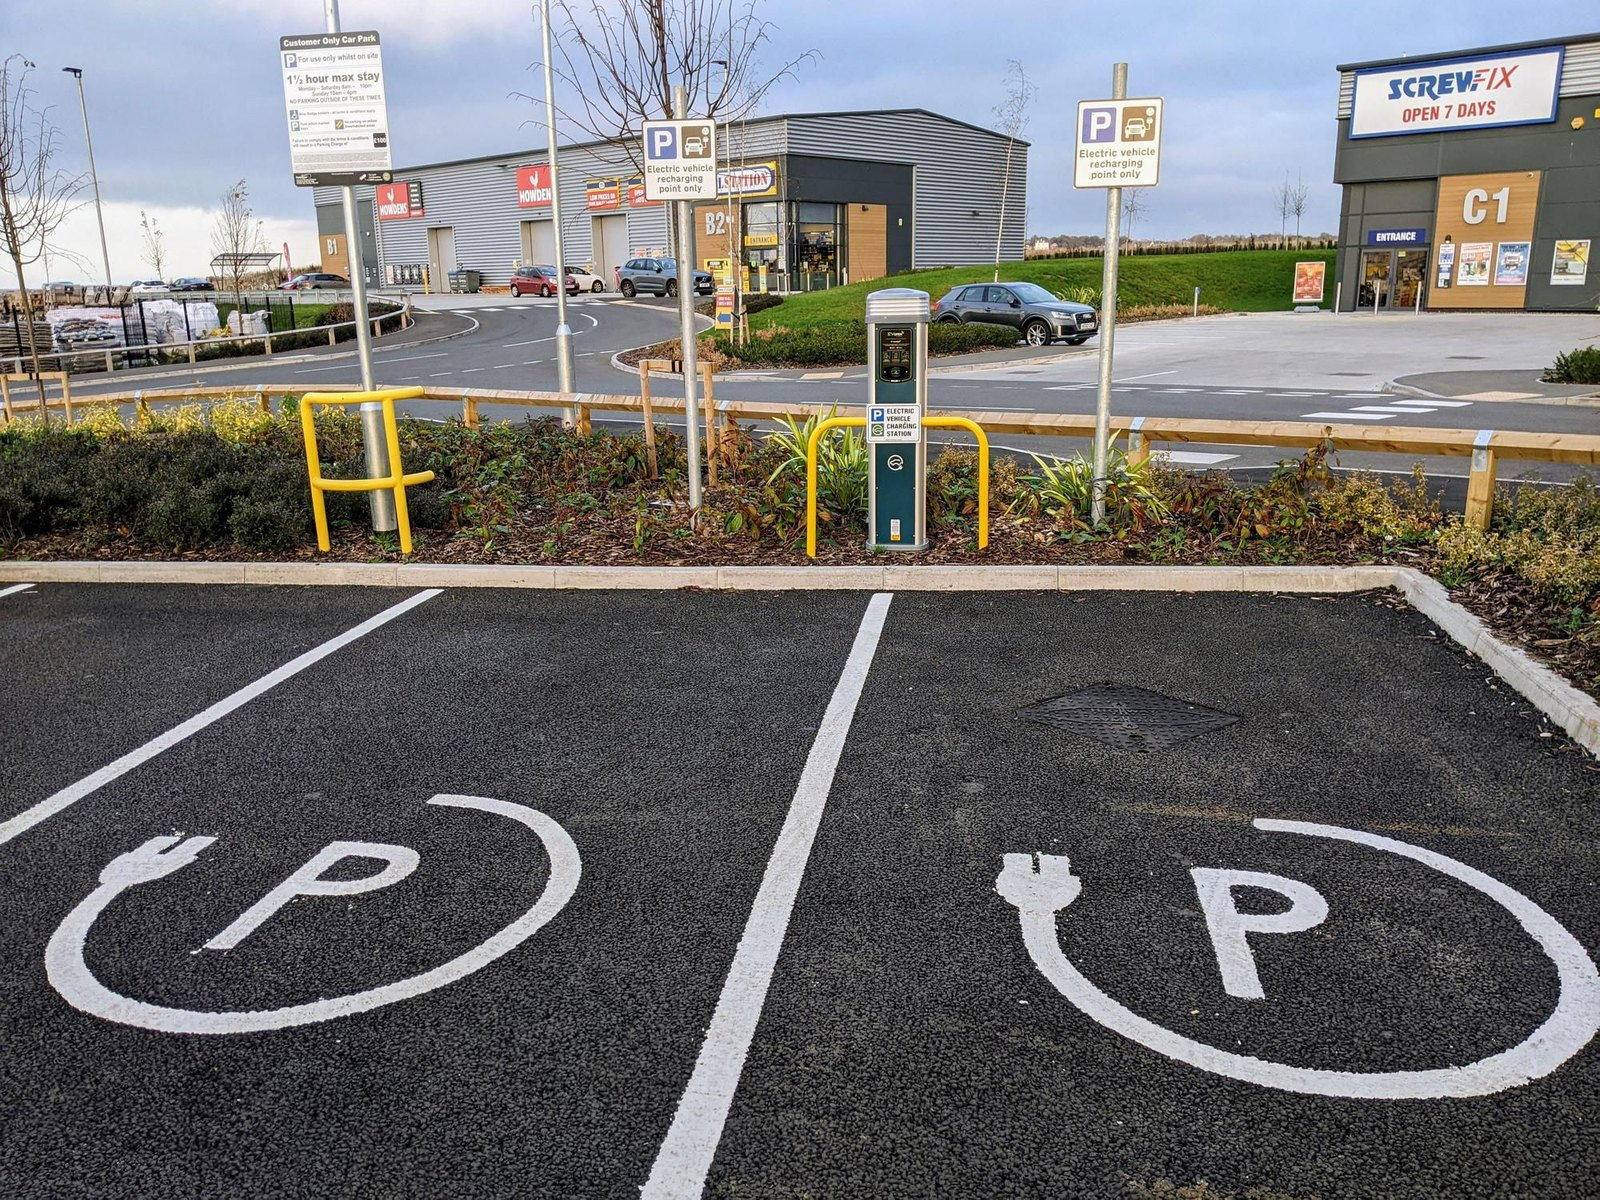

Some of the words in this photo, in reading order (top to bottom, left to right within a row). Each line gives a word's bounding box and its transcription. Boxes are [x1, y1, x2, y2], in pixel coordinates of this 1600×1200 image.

[283, 39, 321, 48] Customer
[322, 37, 340, 46] Only
[341, 36, 356, 44] Car
[357, 34, 376, 43] Park
[322, 54, 336, 63] only
[337, 53, 356, 61] whilst
[305, 74, 329, 84] hour
[331, 73, 354, 83] max
[357, 72, 380, 83] stay
[1388, 65, 1520, 101] SCREWFIX
[1402, 105, 1439, 123] OPEN
[1445, 104, 1453, 119] 7
[1457, 100, 1496, 119] DAYS
[1090, 111, 1112, 140] P
[654, 130, 673, 157] P
[1079, 148, 1118, 158] Electric
[1120, 148, 1156, 157] vehicle
[647, 164, 680, 173] Electric
[683, 163, 714, 172] vehicle
[1089, 159, 1143, 169] recharging
[657, 174, 704, 184] recharging
[718, 171, 769, 189] LSTATION
[1091, 170, 1117, 180] point
[1120, 169, 1141, 179] only
[519, 187, 551, 203] HOWDEN
[659, 184, 681, 194] point
[684, 184, 703, 193] only
[379, 202, 408, 215] HOWDENS
[1463, 187, 1510, 224] C1
[1376, 231, 1416, 242] ENTRANCE
[326, 238, 338, 256] B1
[873, 410, 882, 421] P
[203, 841, 421, 950] P
[1189, 867, 1330, 1000] P
